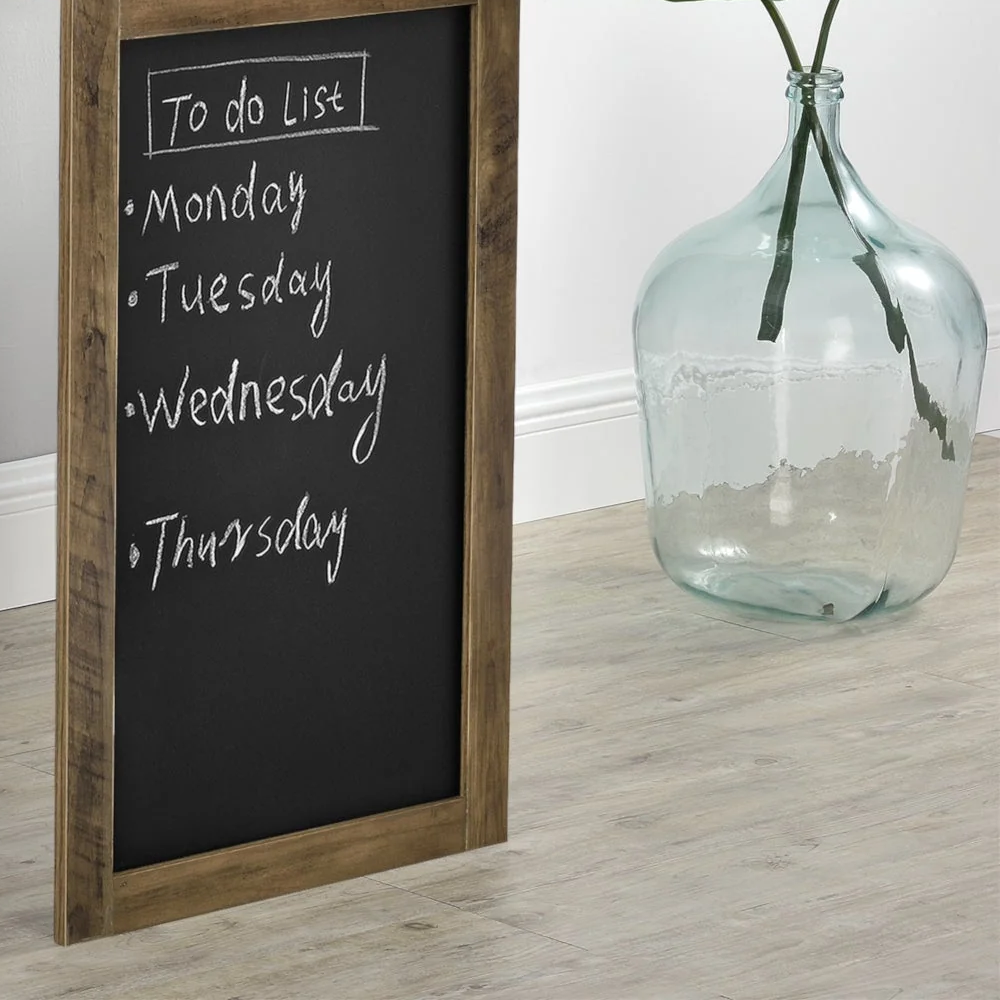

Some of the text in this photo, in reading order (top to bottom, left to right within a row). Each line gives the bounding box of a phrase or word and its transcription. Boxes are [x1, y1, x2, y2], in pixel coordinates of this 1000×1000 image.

[161, 75, 344, 146] To do List
[141, 160, 308, 235] Monday
[145, 251, 332, 339] Tuesday
[137, 348, 387, 465] Wednesday
[145, 491, 348, 591] Thursday
